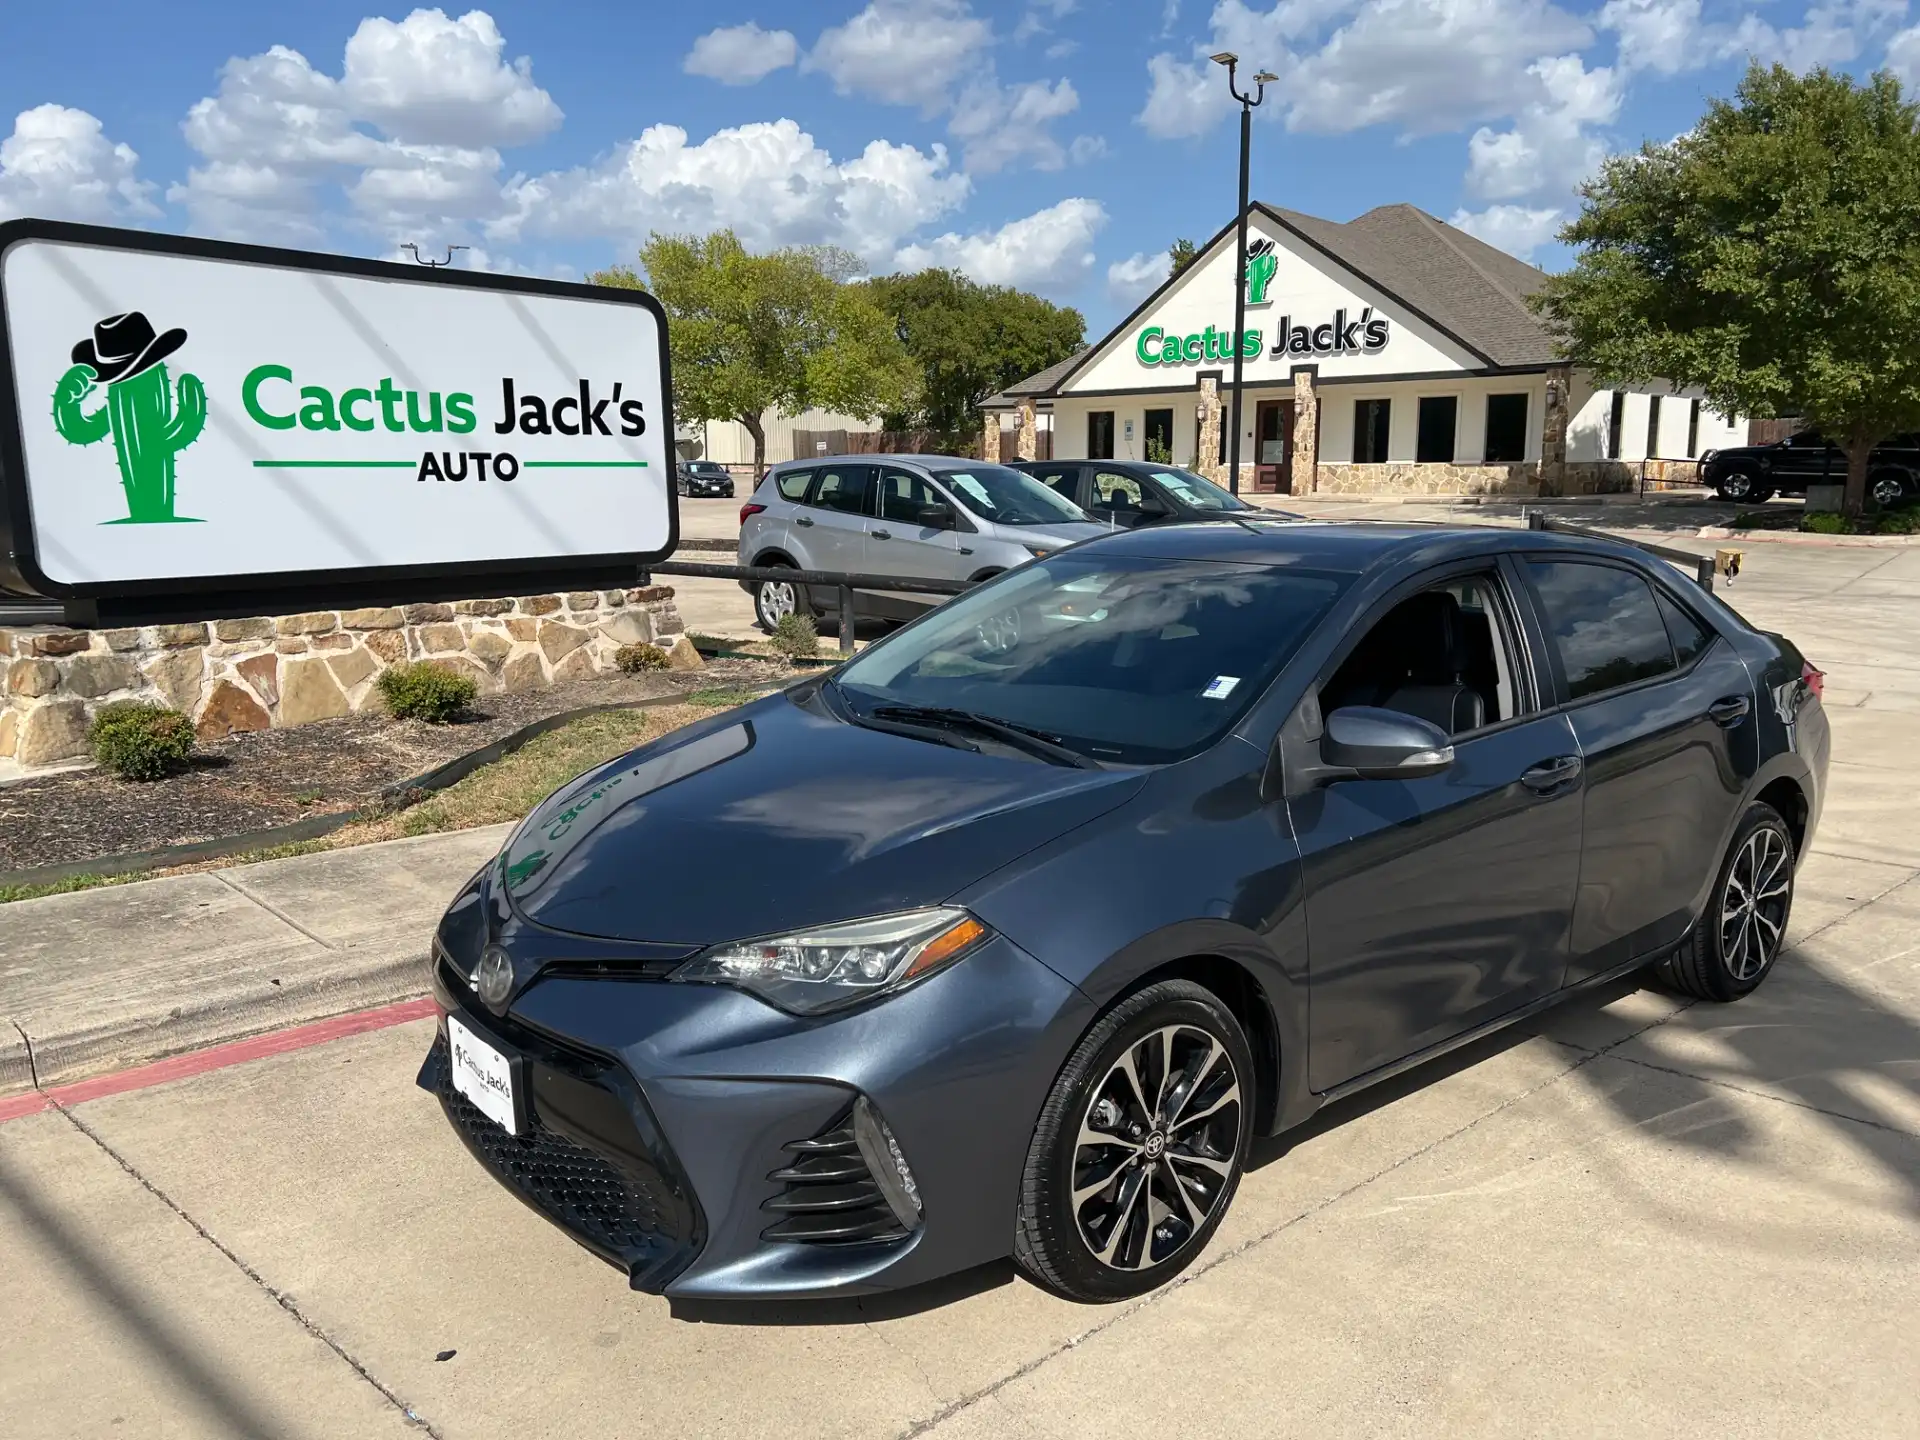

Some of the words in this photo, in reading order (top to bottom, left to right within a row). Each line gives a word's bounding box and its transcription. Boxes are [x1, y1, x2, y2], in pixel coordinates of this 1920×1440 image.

[1136, 326, 1261, 364] Cactus
[1271, 307, 1389, 355] Jack's
[242, 364, 476, 434] Cactus
[494, 378, 646, 437] Jack's
[417, 451, 519, 482] AUTO
